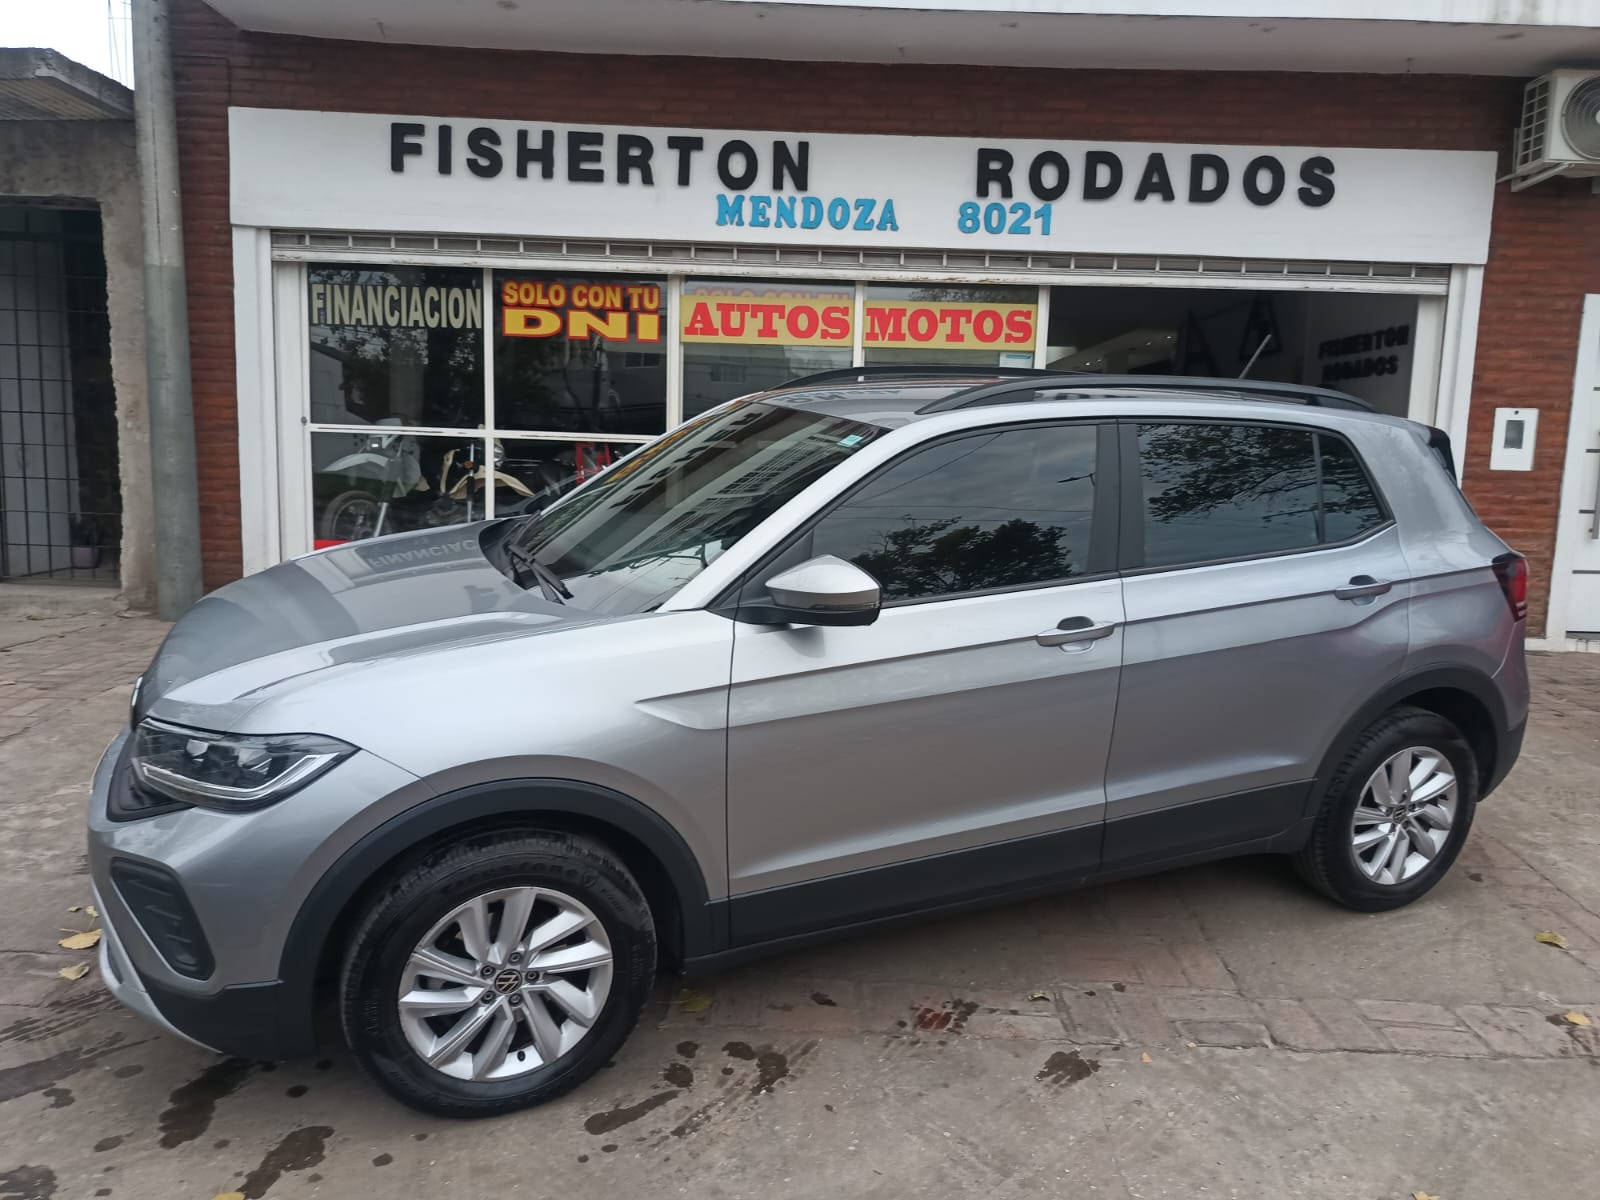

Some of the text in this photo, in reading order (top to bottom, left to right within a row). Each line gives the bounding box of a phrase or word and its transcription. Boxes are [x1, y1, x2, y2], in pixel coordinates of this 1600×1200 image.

[390, 122, 1336, 207] FISHERTON RODADOS
[716, 194, 1053, 236] MENDOZA 8021
[311, 283, 482, 329] FINANCIACION
[503, 280, 567, 307] SOLO
[571, 284, 623, 310] CON
[627, 285, 661, 311] TU
[502, 306, 661, 343] DNI
[684, 302, 850, 340] AUTOS
[865, 307, 1033, 344] MOTOS
